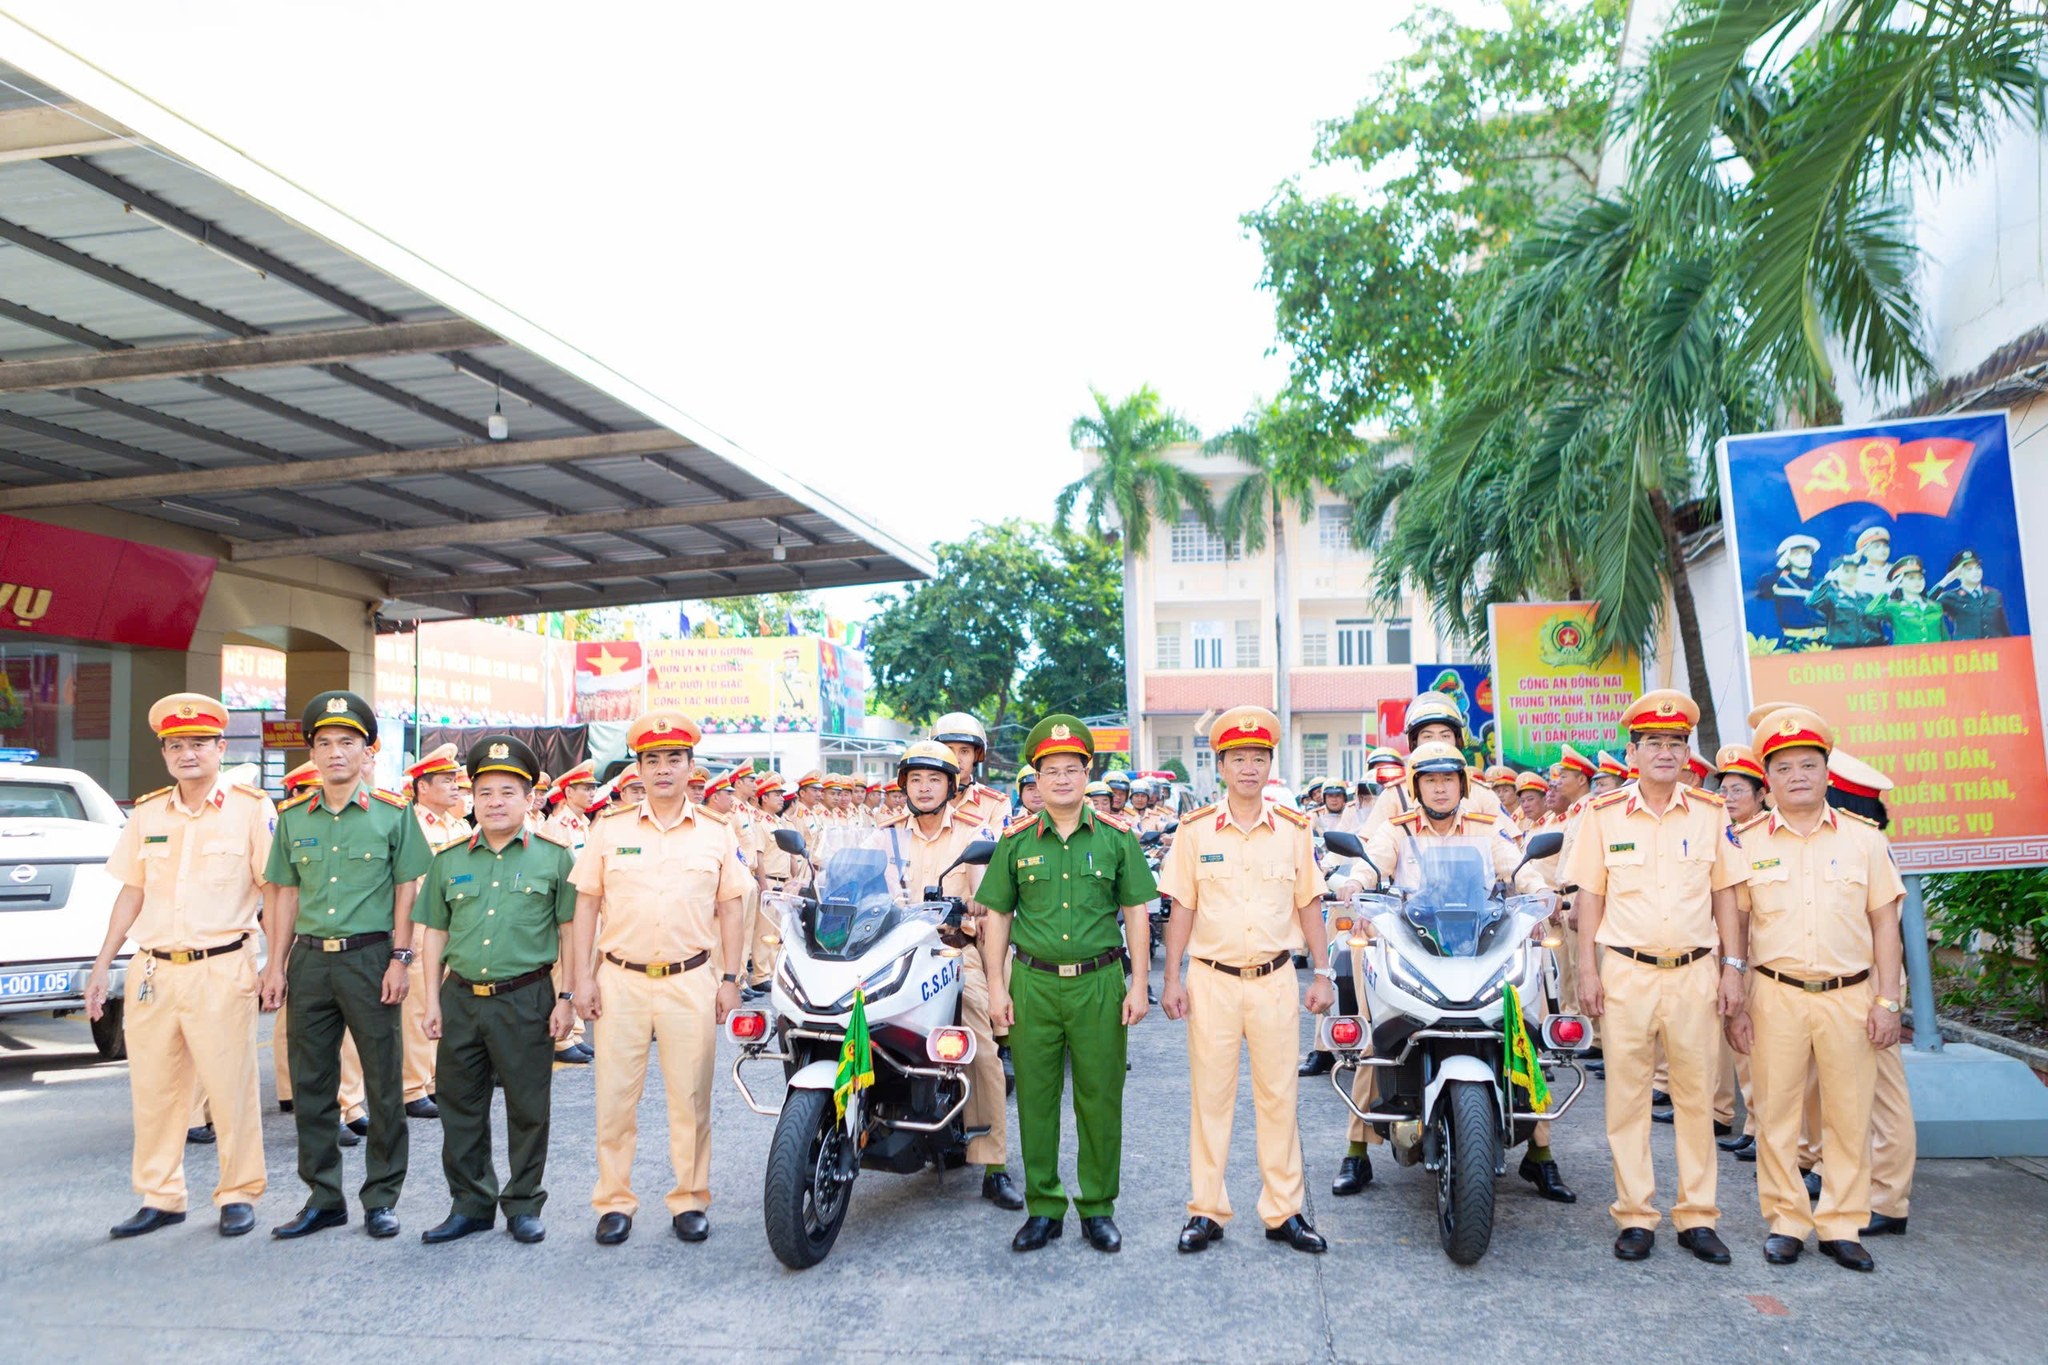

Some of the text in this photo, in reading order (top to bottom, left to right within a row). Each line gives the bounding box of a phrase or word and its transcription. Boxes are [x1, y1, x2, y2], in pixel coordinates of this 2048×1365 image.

[1788, 649, 1998, 685] CÔNG AN NHÂN DÂN
[1519, 673, 1622, 690] CÔNG AN ĐỒNG NAI
[1509, 695, 1545, 708] TRUNG
[1846, 687, 1947, 714] VIỆT NAM
[1565, 709, 1593, 724] QUÊN
[1847, 721, 1917, 743] THÀNH
[1922, 715, 1958, 739] VỚI
[1963, 711, 2029, 736] ĐẢNG,
[1545, 728, 1567, 742] DÂN
[1903, 748, 1938, 772] VỚI
[1944, 746, 1996, 770] DÂN,
[1890, 777, 2016, 805] QUÊN THÂN,
[1902, 814, 1960, 838] PHỤC
[1965, 811, 1994, 836] VỤ
[0, 972, 68, 994] -001.05
